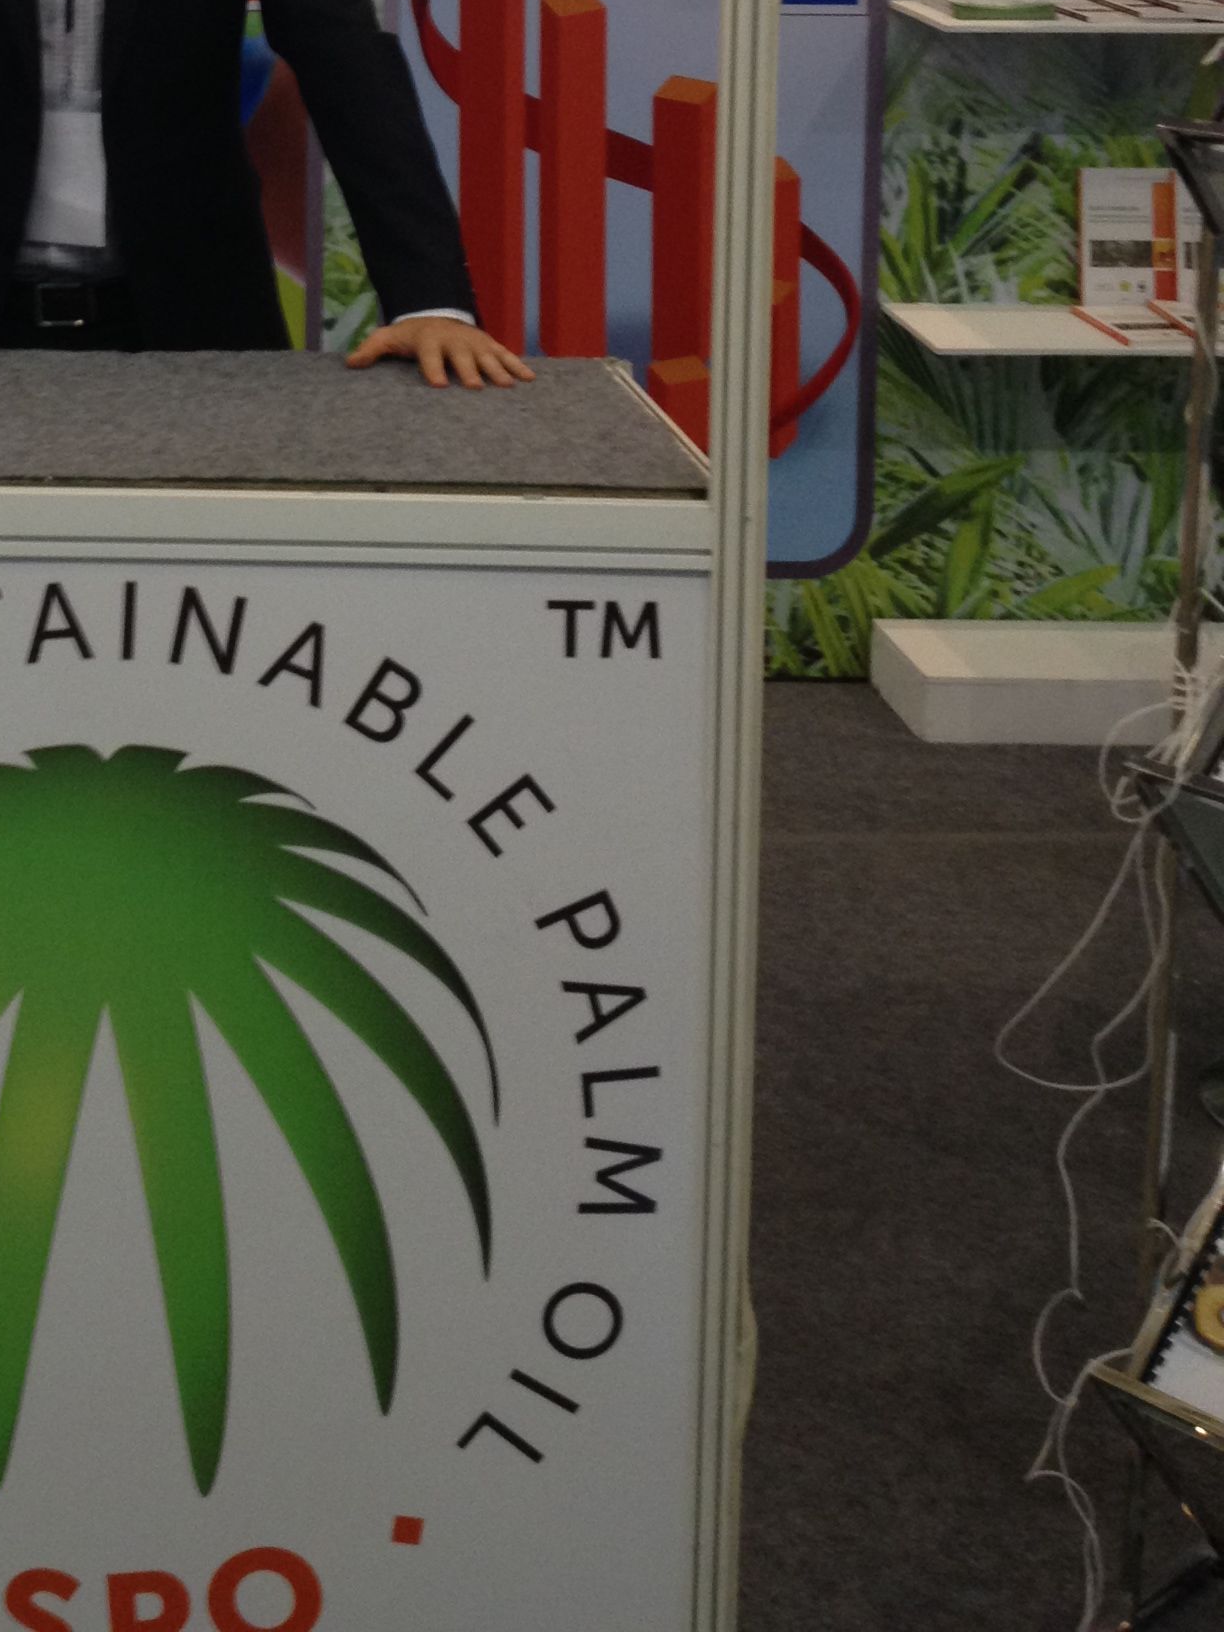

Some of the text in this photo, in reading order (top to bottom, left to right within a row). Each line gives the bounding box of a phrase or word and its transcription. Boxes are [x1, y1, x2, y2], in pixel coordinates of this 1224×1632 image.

[547, 599, 662, 660] TM
[532, 887, 664, 1217] PALM
[454, 1279, 626, 1465] OIL
